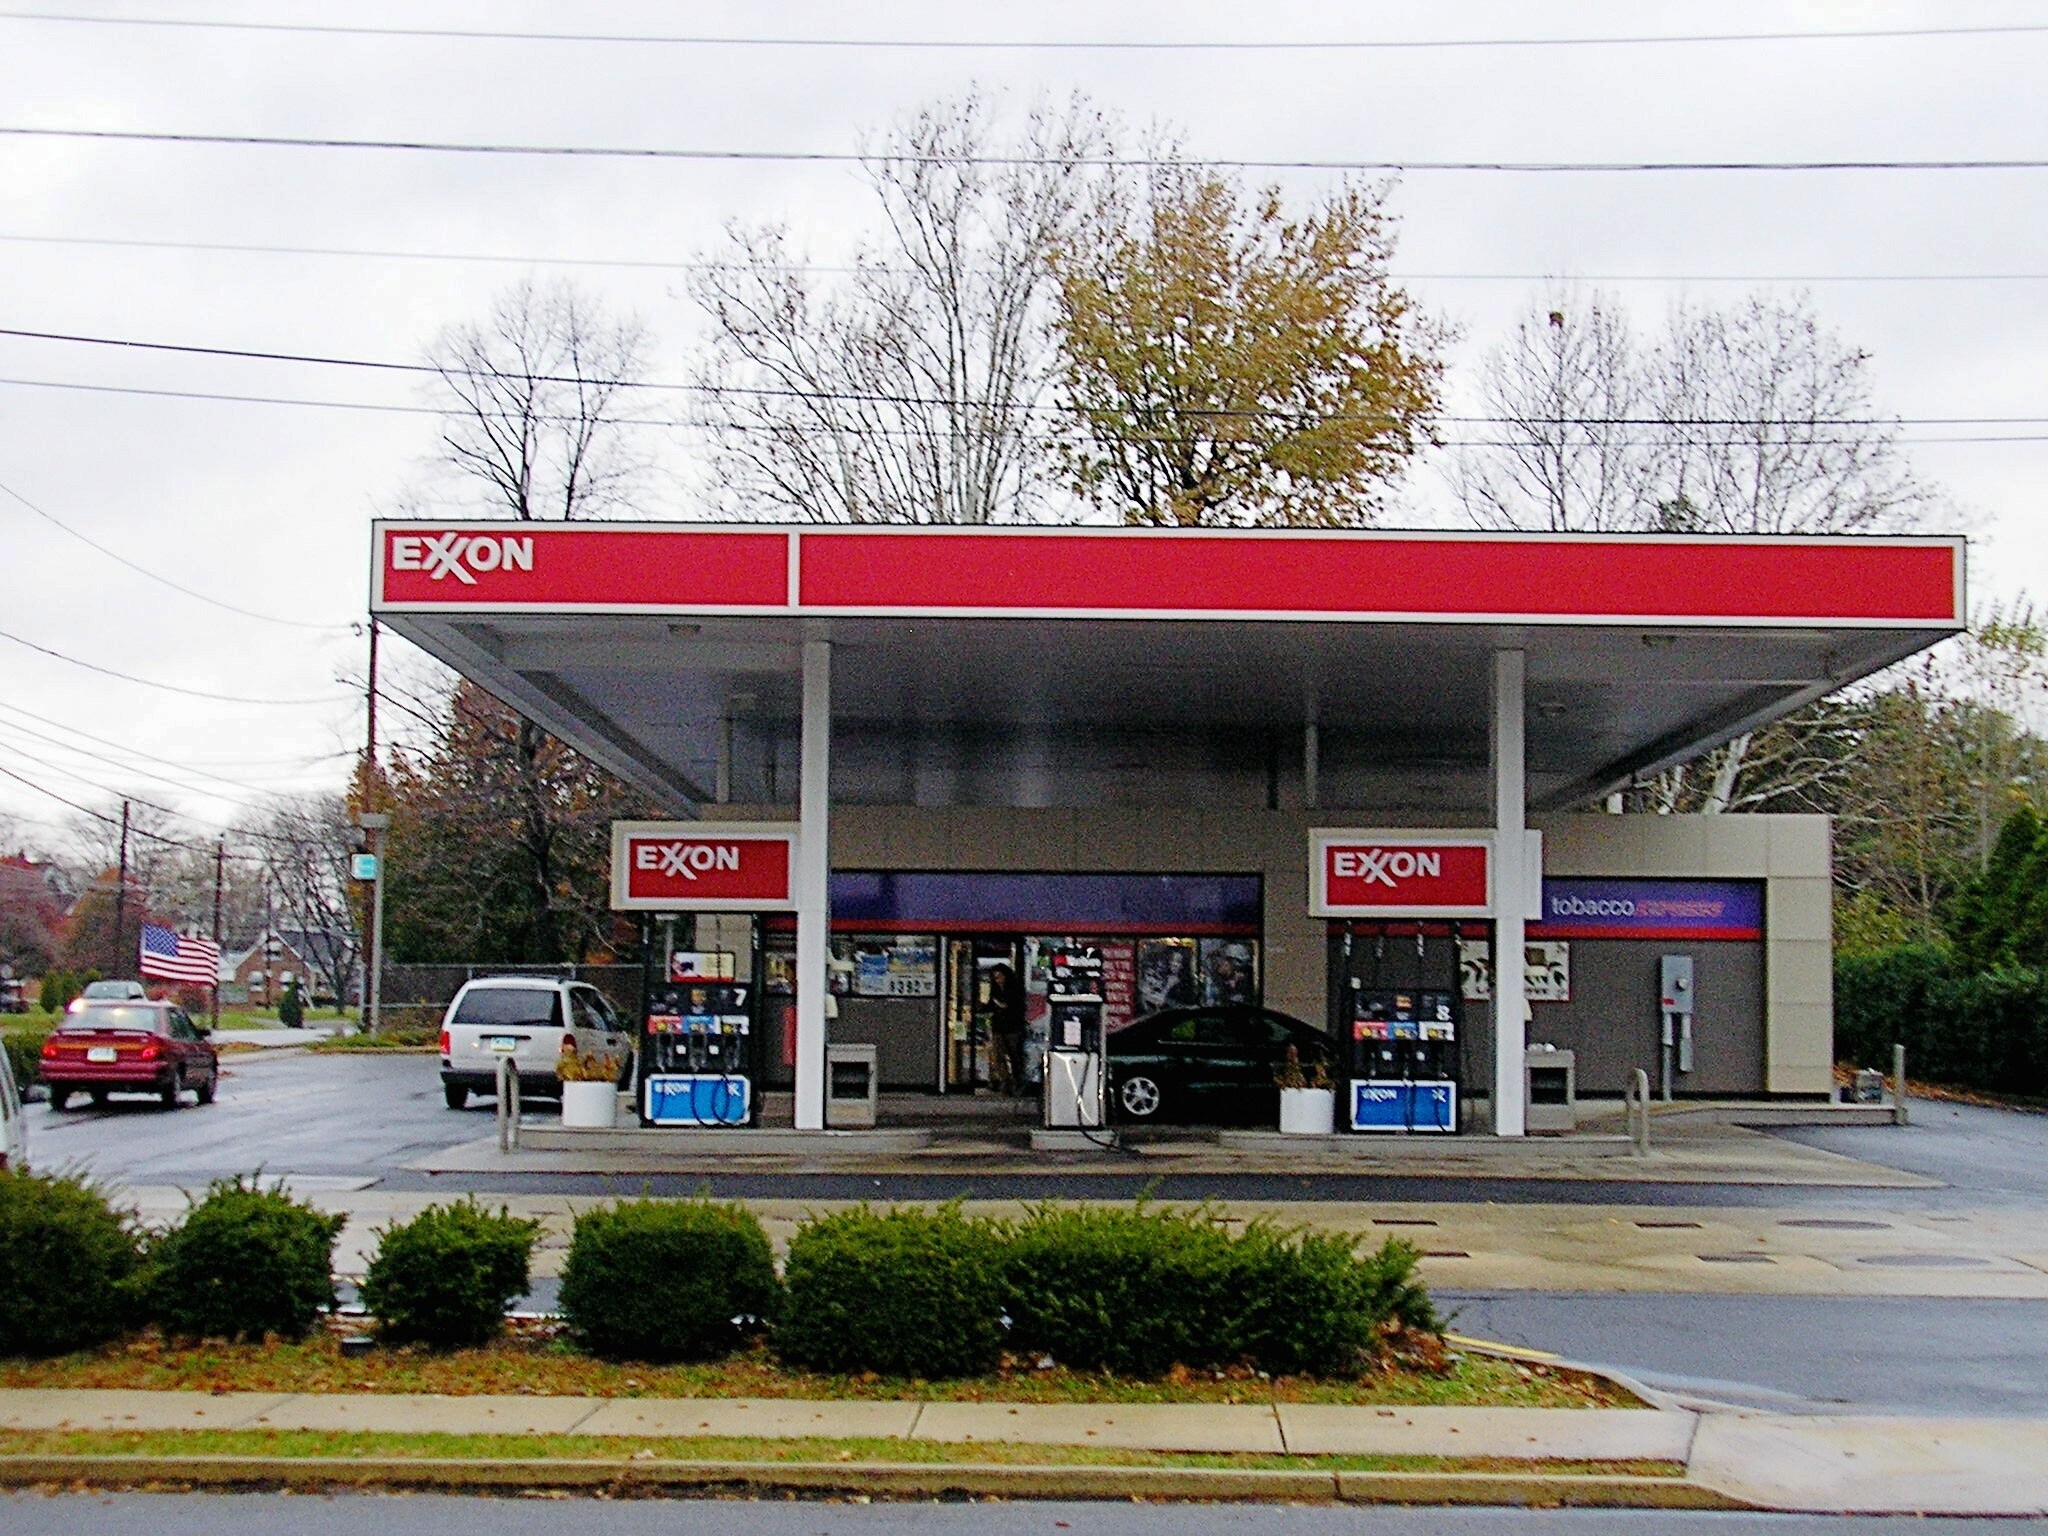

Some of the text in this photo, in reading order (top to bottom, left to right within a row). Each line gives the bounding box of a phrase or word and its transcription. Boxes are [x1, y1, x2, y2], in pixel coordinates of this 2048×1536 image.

[392, 532, 535, 585] EXXON
[636, 842, 740, 880] EXXON
[1333, 848, 1441, 888] EXXON
[1552, 894, 1635, 916] tobacco
[733, 988, 748, 1007] 7
